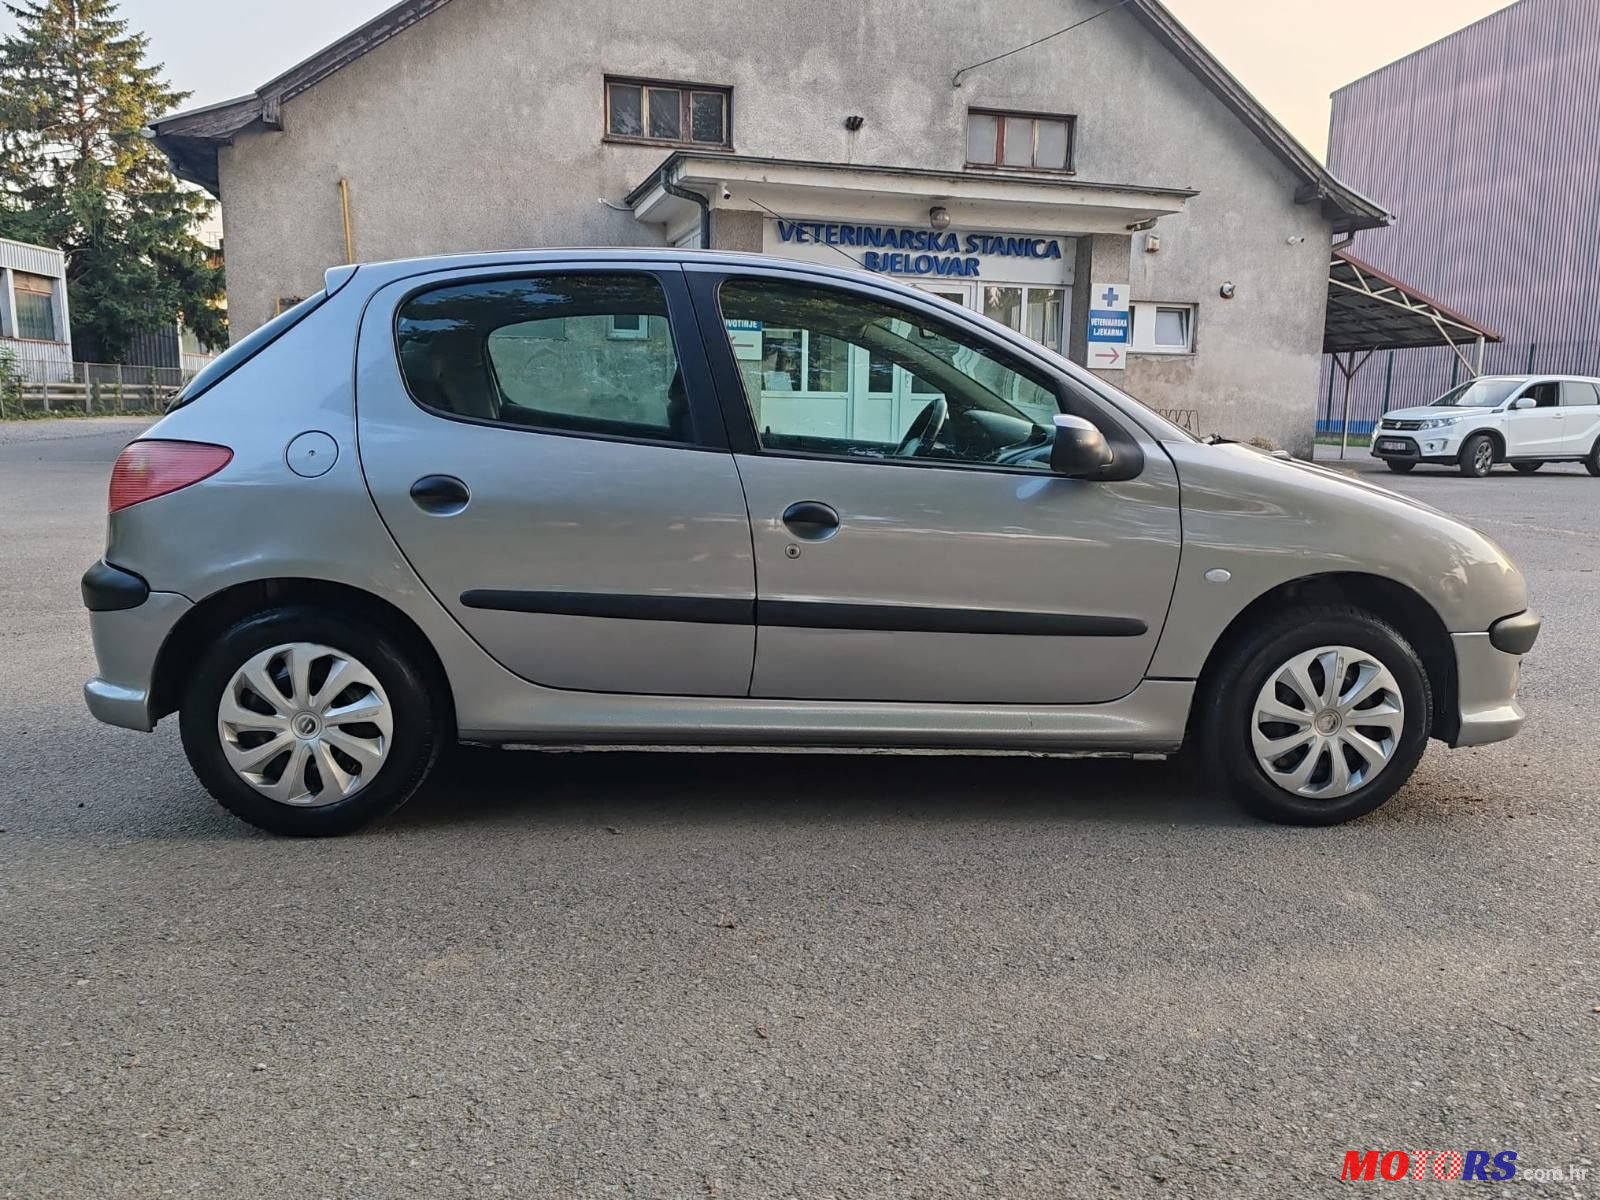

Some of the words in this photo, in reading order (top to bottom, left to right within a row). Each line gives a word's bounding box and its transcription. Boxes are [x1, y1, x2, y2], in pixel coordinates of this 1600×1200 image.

[778, 221, 961, 252] VETERINARSKA
[965, 234, 1062, 259] STANICA
[864, 252, 980, 276] BJELOVAR
[1090, 318, 1127, 327] VETERINARSKA
[1093, 328, 1124, 337] LJEKARNA
